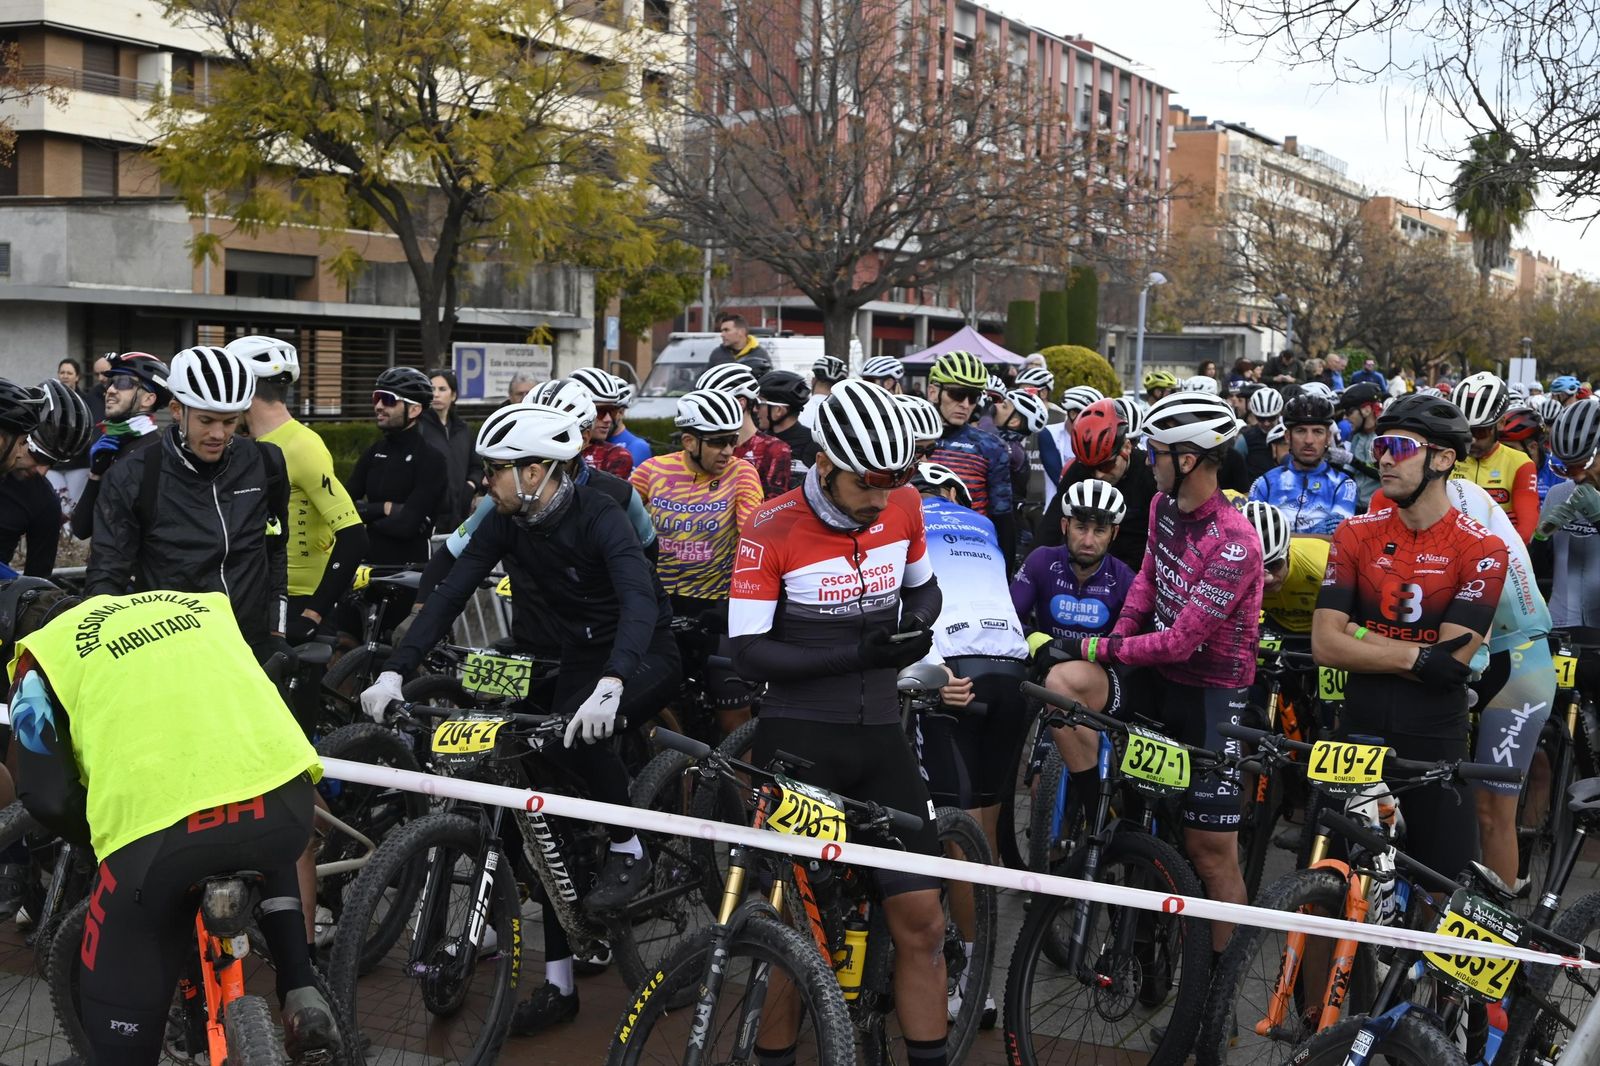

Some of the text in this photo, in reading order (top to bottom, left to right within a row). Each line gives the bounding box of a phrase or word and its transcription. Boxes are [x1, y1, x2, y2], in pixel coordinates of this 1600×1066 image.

[461, 349, 482, 395] P
[652, 498, 727, 513] CICLOSCONDE
[759, 500, 797, 519] ESCAYESCOS
[297, 500, 309, 557] FASTER
[741, 545, 756, 560] PYL
[949, 548, 992, 561] Jarmauto
[821, 563, 894, 587] escayescos
[818, 576, 896, 603] Imporalia
[1059, 599, 1099, 614] COFERPU
[76, 593, 211, 658] PERSONAL AUXILIAR
[105, 613, 202, 660] HABILITADO
[946, 621, 970, 635] 226ERS
[1365, 619, 1438, 643] ESPEJO
[468, 657, 527, 691] 337-2
[437, 722, 500, 747] 204-2
[1128, 738, 1184, 781] 327-1
[1314, 743, 1382, 776] 219-2
[1146, 774, 1166, 783] ROBLES
[776, 793, 841, 842] 203-1
[526, 812, 578, 902] ECIALIZED
[1472, 911, 1504, 932] BIKE RACE
[511, 918, 522, 988] MAXXIS
[1454, 970, 1479, 987] HIDALGO
[619, 970, 665, 1044] MAXXIS
